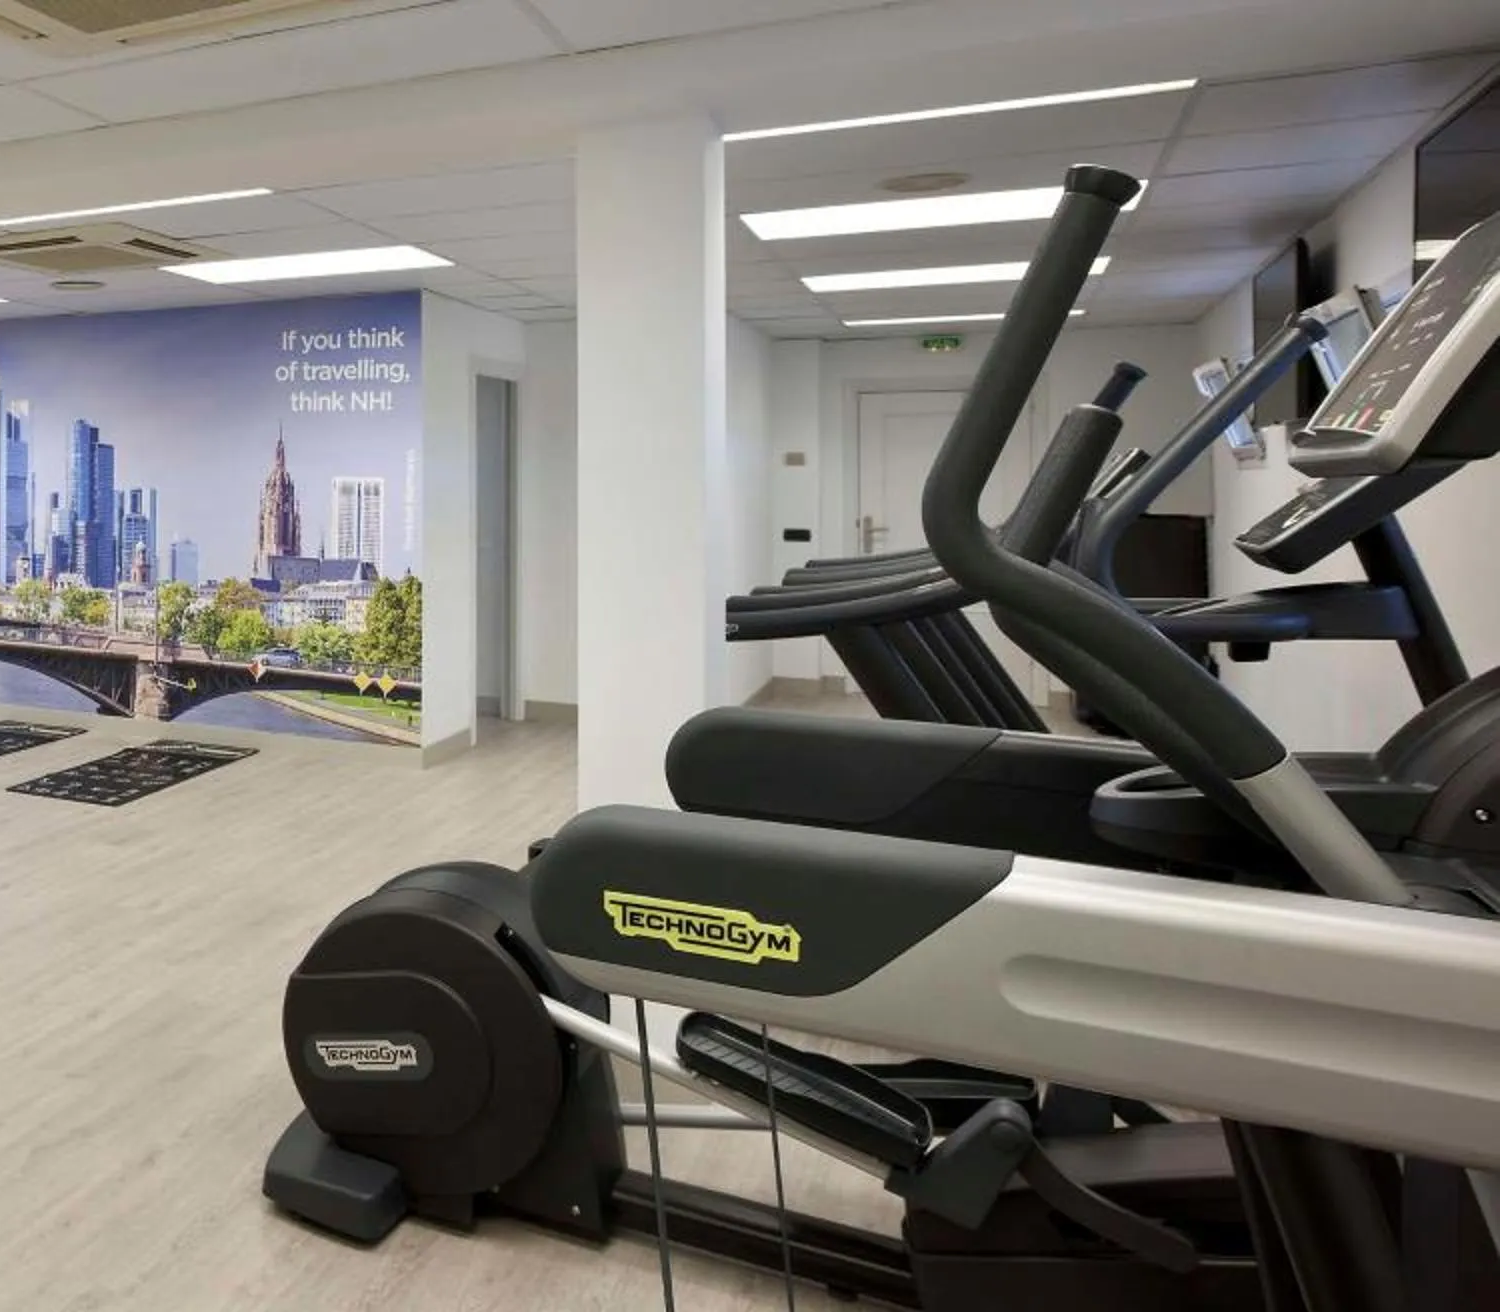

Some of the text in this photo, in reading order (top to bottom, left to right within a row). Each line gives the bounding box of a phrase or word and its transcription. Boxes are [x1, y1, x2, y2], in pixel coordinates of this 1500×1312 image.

[282, 326, 404, 354] If you think
[275, 358, 410, 383] of travelling,
[291, 390, 393, 412] think NH!
